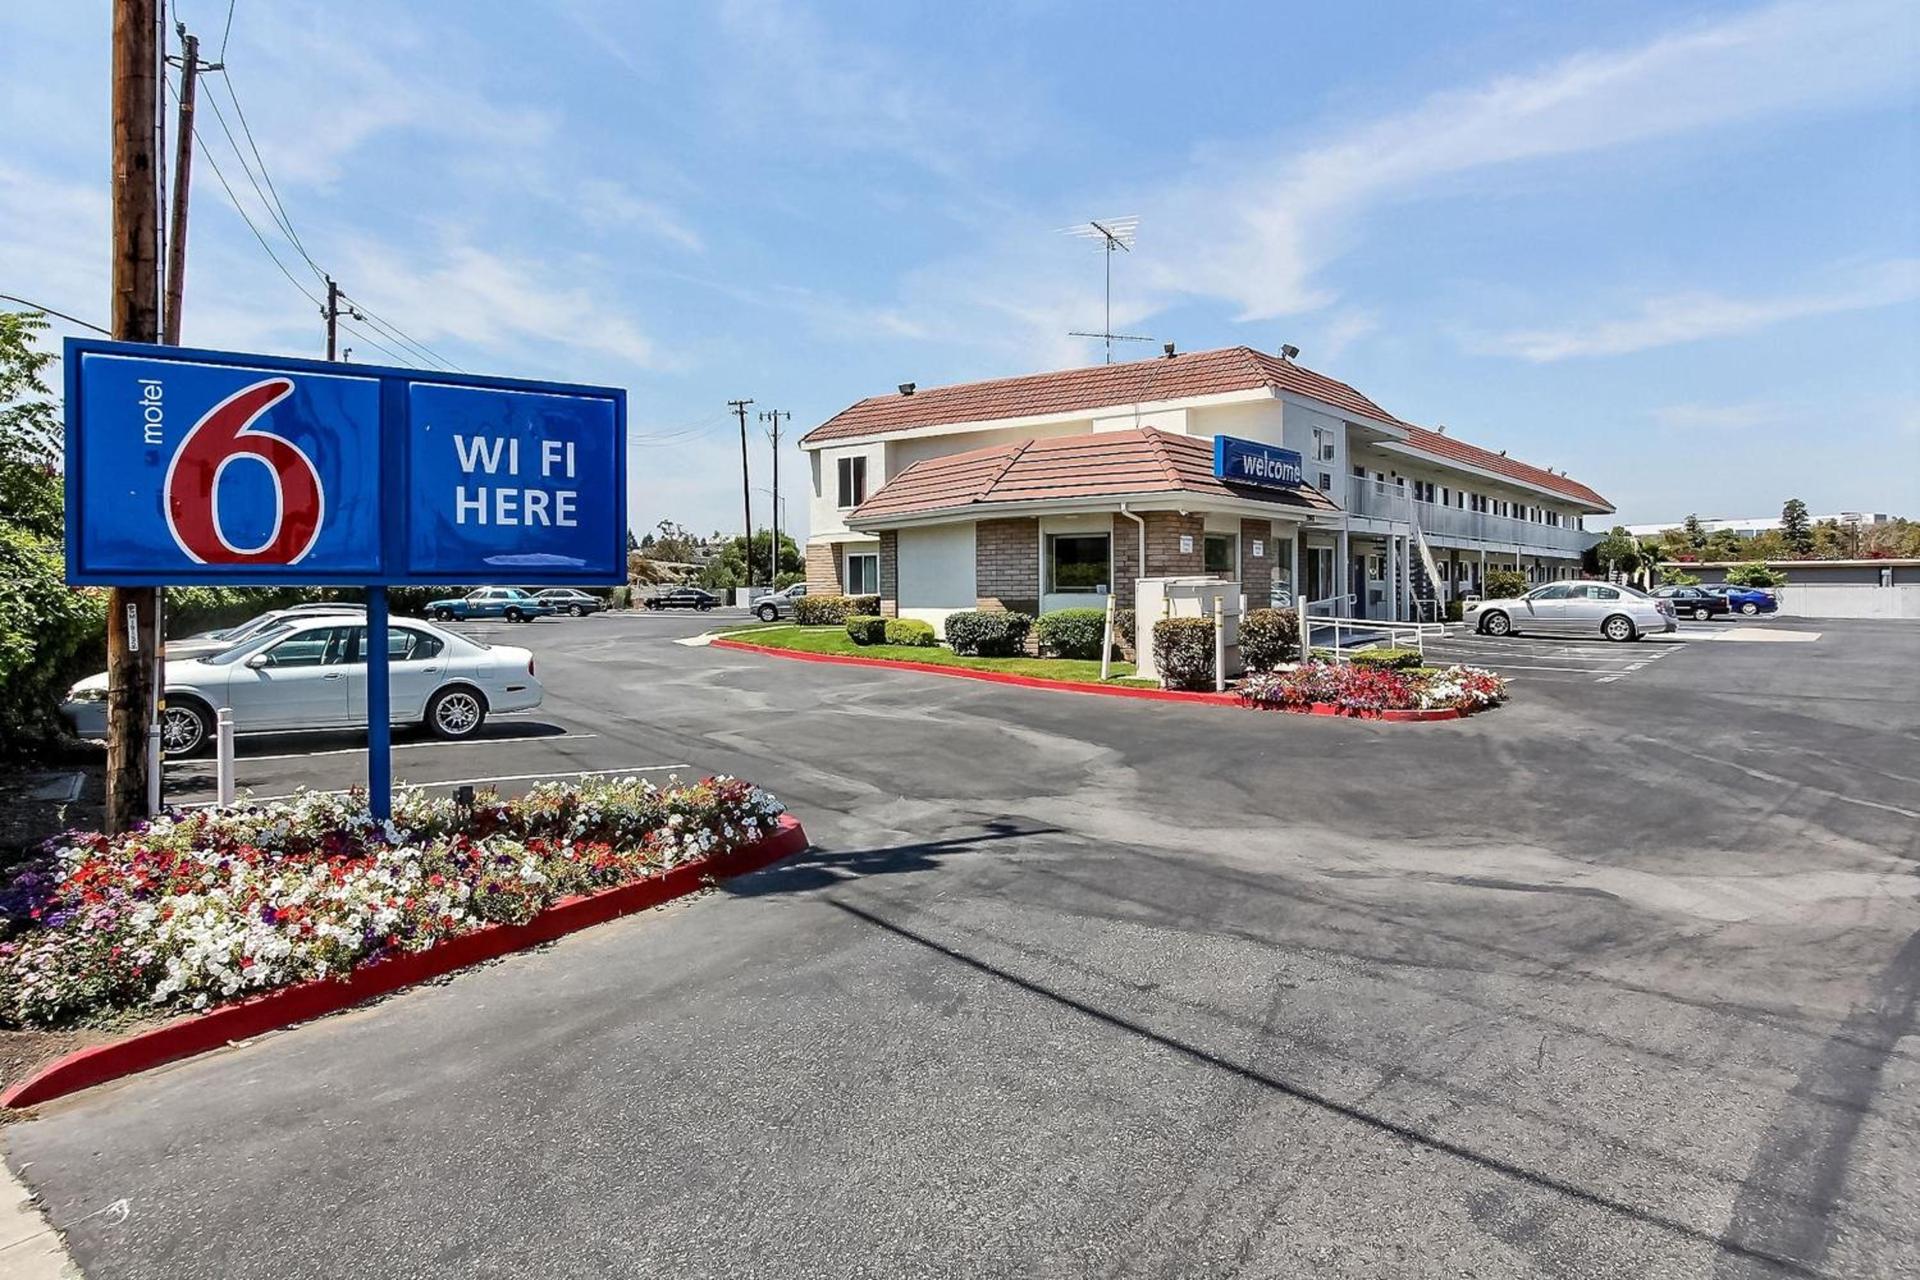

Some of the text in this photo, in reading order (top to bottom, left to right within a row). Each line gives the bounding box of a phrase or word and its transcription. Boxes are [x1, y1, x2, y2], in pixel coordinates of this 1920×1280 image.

[138, 377, 325, 565] motel 6
[453, 434, 575, 478] WI FI
[1242, 450, 1300, 483] welcome
[456, 486, 578, 527] HERE
